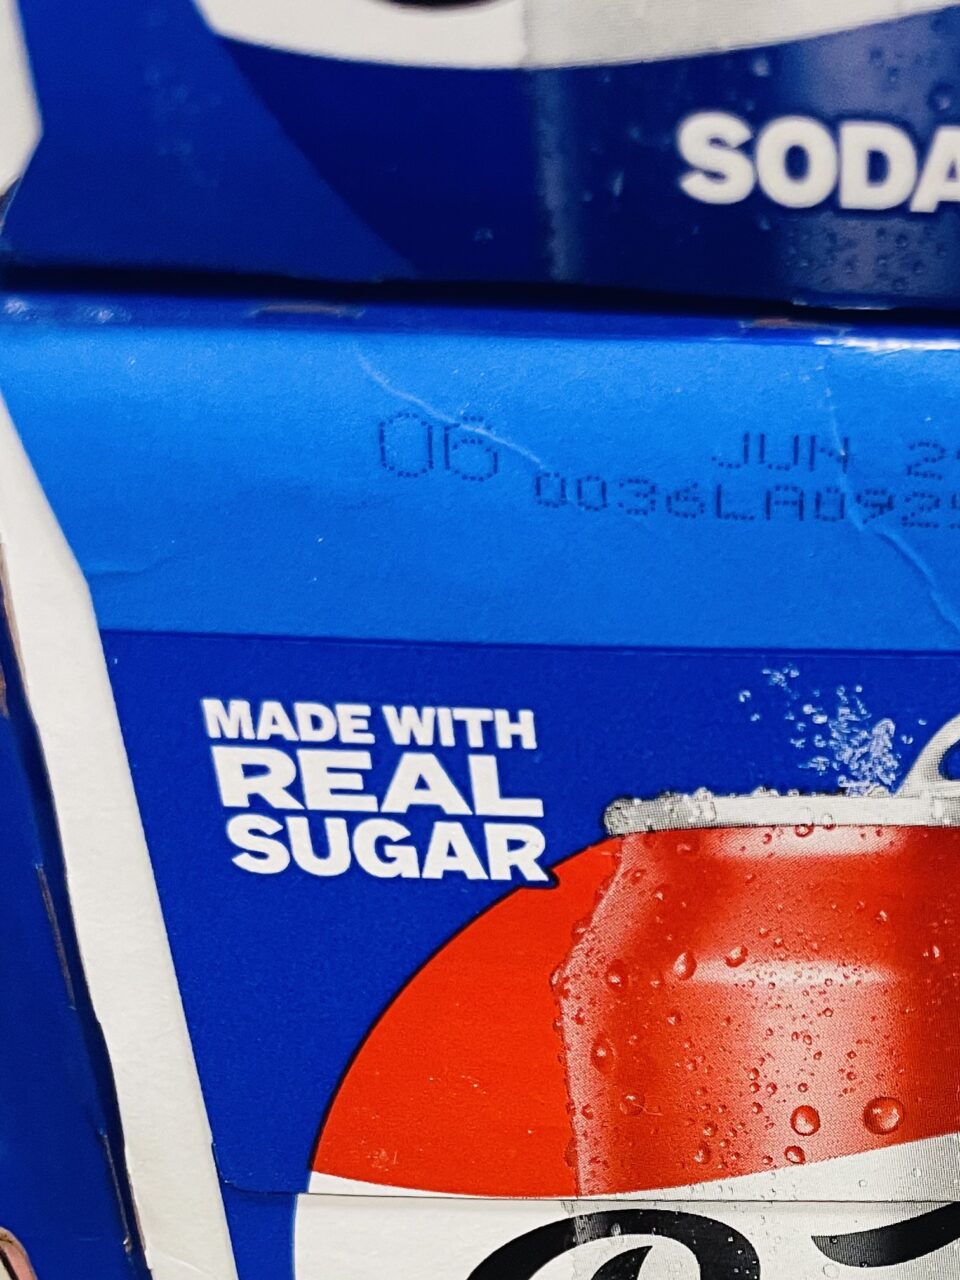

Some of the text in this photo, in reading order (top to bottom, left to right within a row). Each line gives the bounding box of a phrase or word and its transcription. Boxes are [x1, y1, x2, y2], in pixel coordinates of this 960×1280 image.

[379, 413, 499, 482] 06
[712, 432, 850, 473] JUN
[201, 698, 537, 749] MADE WITH
[210, 745, 544, 817] REAL
[226, 813, 549, 882] SUGAR
